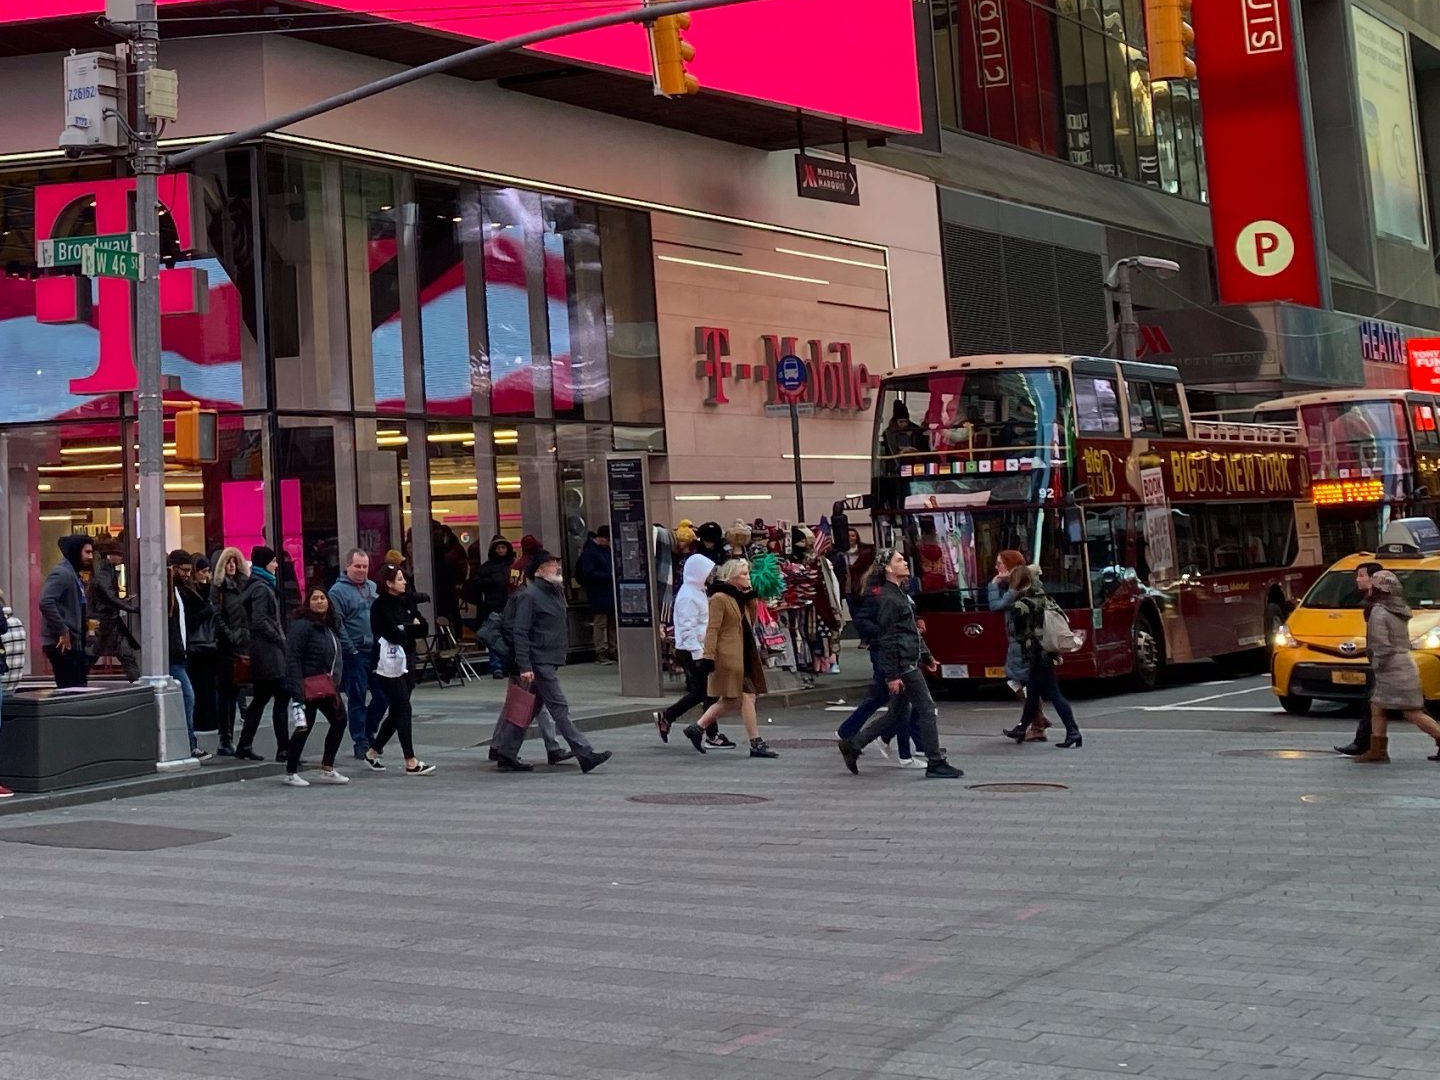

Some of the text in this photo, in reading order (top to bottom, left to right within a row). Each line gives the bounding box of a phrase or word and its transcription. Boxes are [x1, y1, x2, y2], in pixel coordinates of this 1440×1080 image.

[68, 86, 96, 102] 726162
[817, 168, 848, 179] MARRIOTT
[818, 180, 845, 191] MARQUIS
[59, 238, 129, 261] Brodway
[1254, 232, 1279, 267] P
[97, 253, 108, 273] W
[112, 255, 127, 275] 46
[1225, 451, 1256, 492] NEW
[1258, 451, 1291, 491] YORK
[1039, 487, 1054, 499] 92
